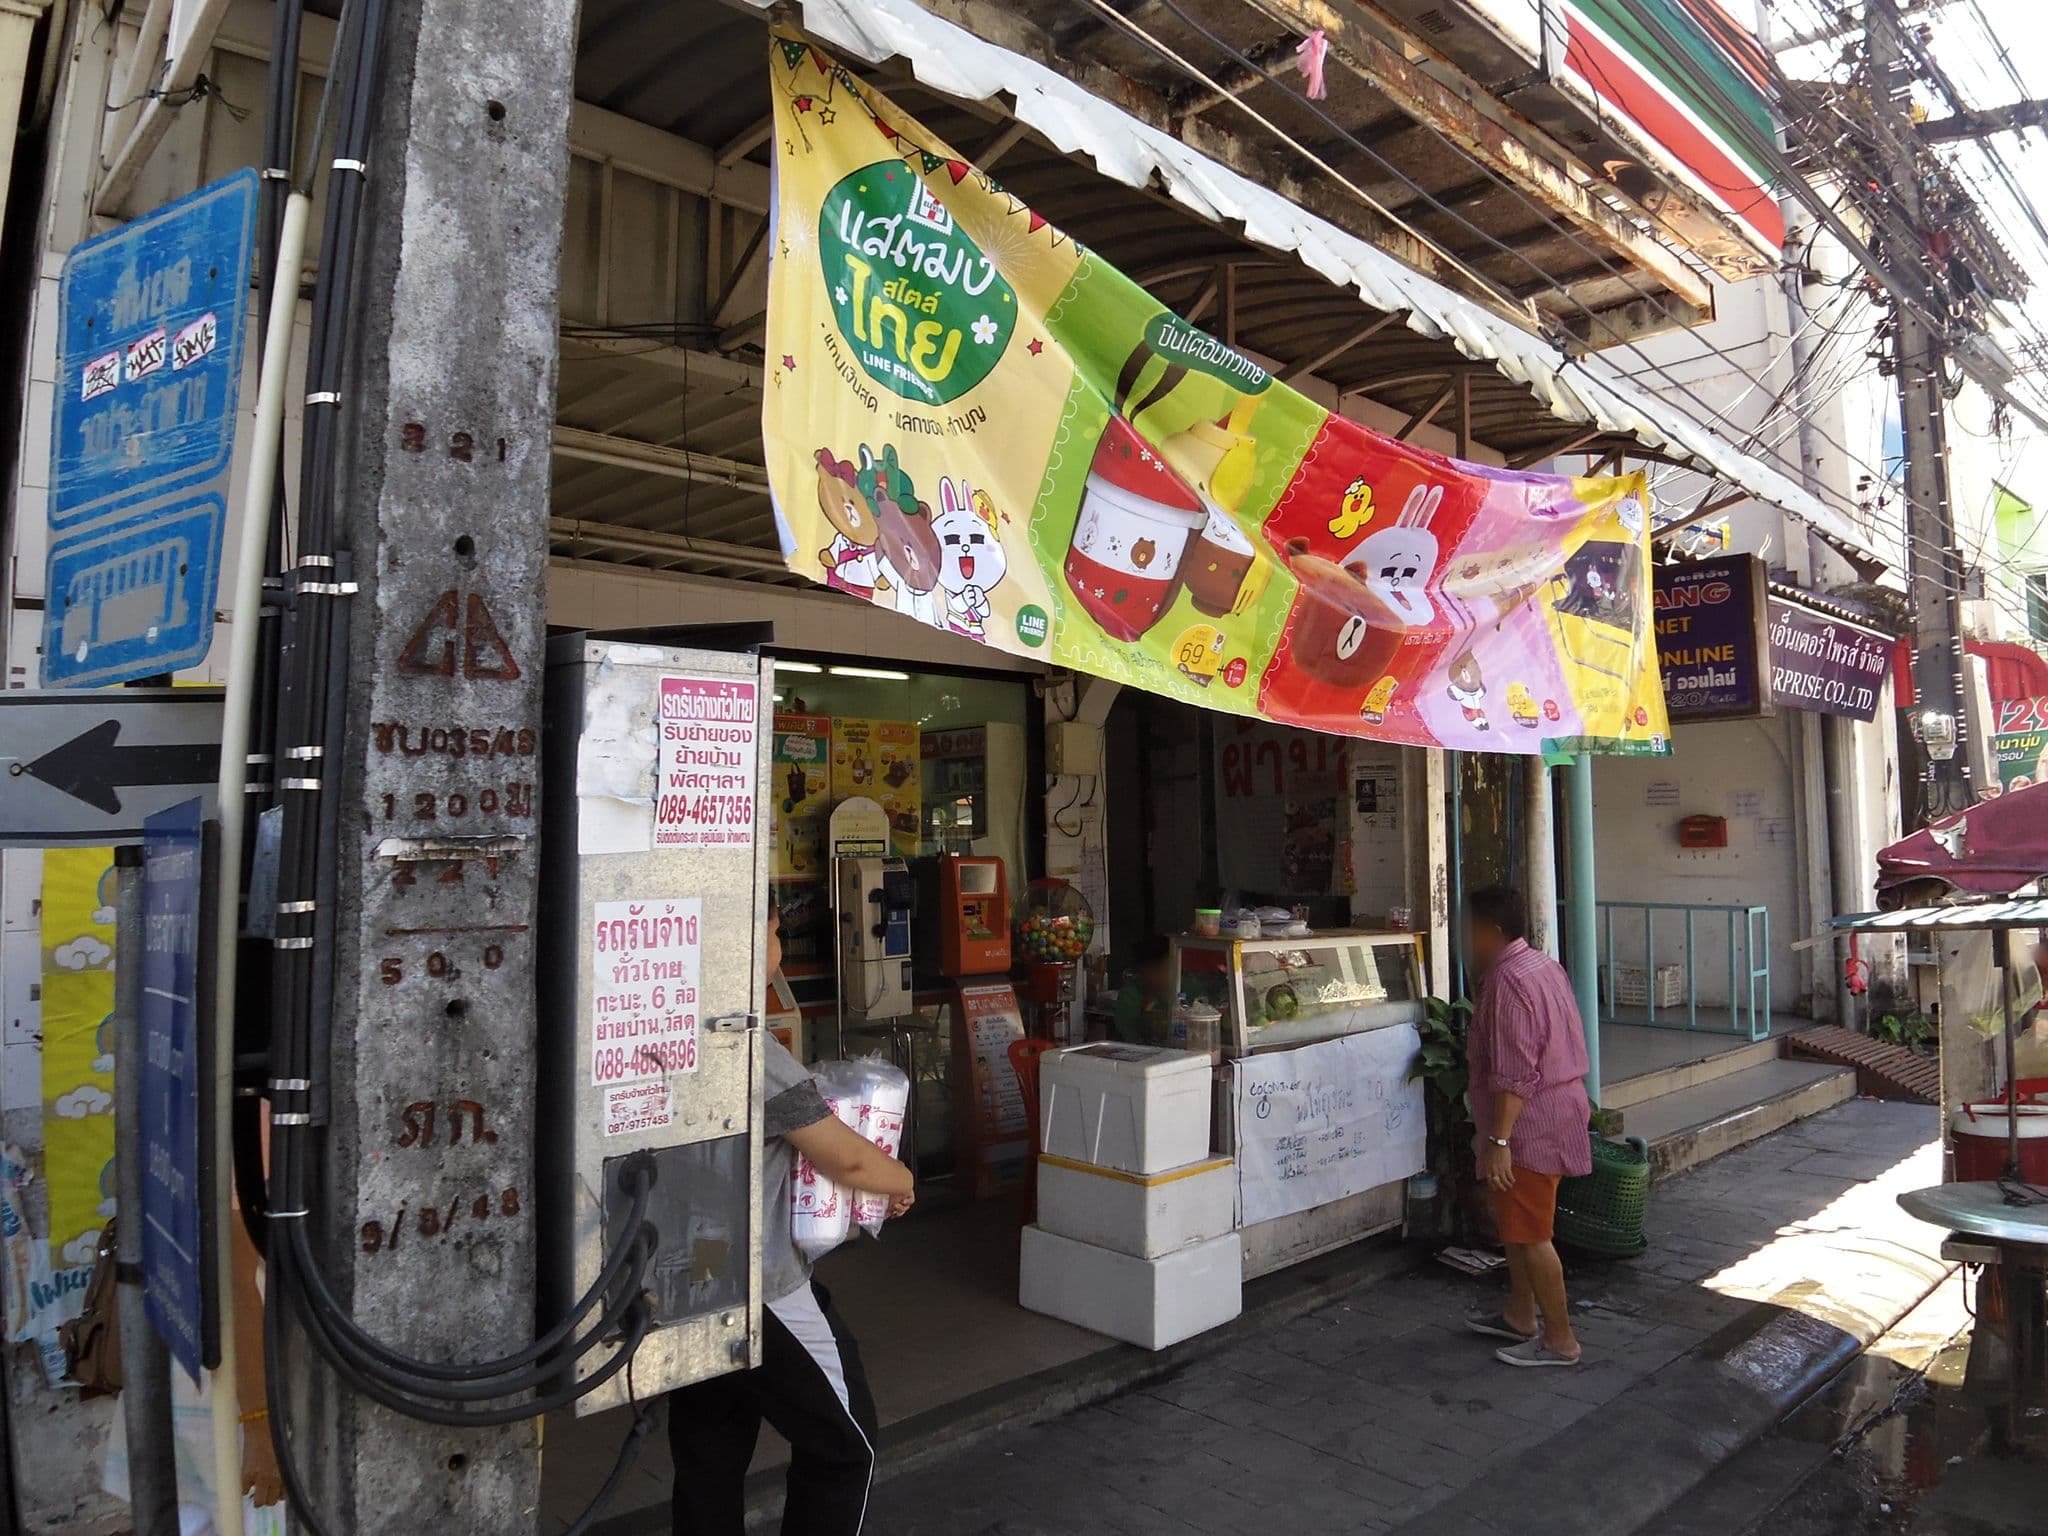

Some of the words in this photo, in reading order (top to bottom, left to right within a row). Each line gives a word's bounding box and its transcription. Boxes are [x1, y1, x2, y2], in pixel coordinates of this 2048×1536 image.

[882, 277, 941, 315] สไตล์
[845, 253, 962, 382] ไทย
[863, 351, 892, 373] LINE
[1022, 614, 1046, 630] LINE
[1180, 642, 1205, 665] 69
[1659, 644, 1735, 667] NLINE
[1769, 610, 1862, 667] เอ็นเตอร์ไพรส์
[1859, 643, 1885, 675] จำกัด
[1677, 667, 1737, 690] ออนไลน์
[1771, 666, 1825, 699] RPRISE
[663, 684, 753, 722] รถรับจ้างทั่วไทย
[663, 722, 752, 744] รับย้ายของ
[675, 745, 741, 766] ย้ายบ้าน
[669, 769, 745, 793] พัสดุฯลฯ
[658, 795, 752, 825] 089-4657356
[597, 904, 698, 952] รถรับจ้าง
[612, 951, 683, 984] ทั่วไทย
[651, 985, 666, 1009] 6
[675, 979, 696, 1005] ล้อ
[608, 1114, 669, 1134] 087-9757458
